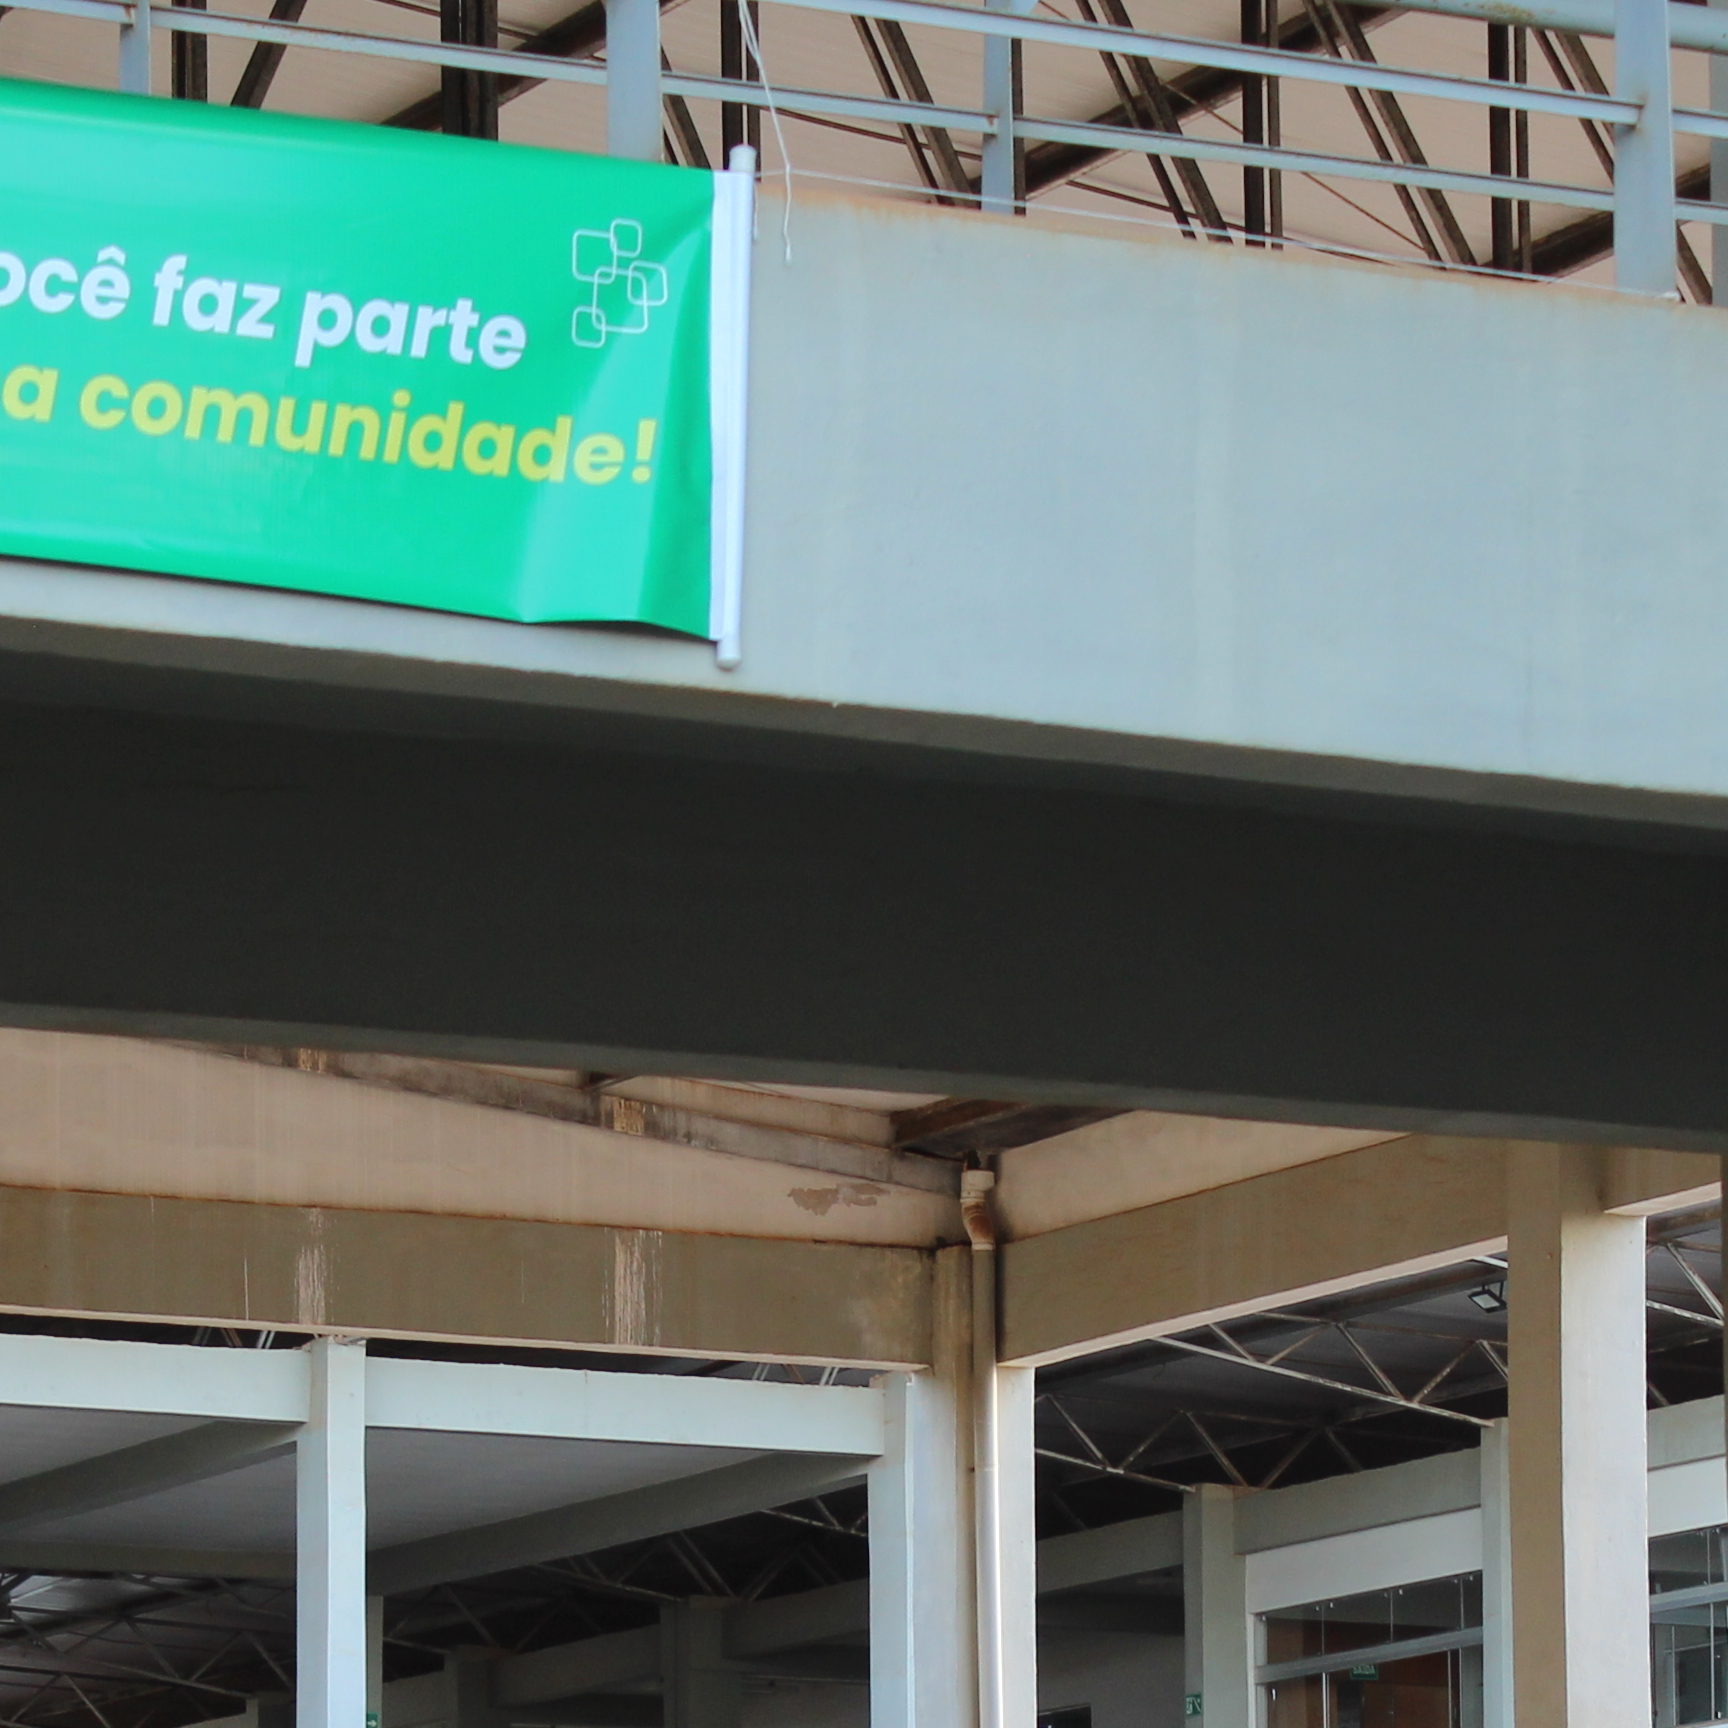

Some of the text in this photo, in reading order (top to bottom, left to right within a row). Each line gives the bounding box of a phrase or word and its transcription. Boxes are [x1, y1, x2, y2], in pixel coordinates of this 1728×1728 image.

[153, 254, 280, 339] faz
[293, 289, 526, 370] parte
[79, 372, 657, 484] comunidade!
